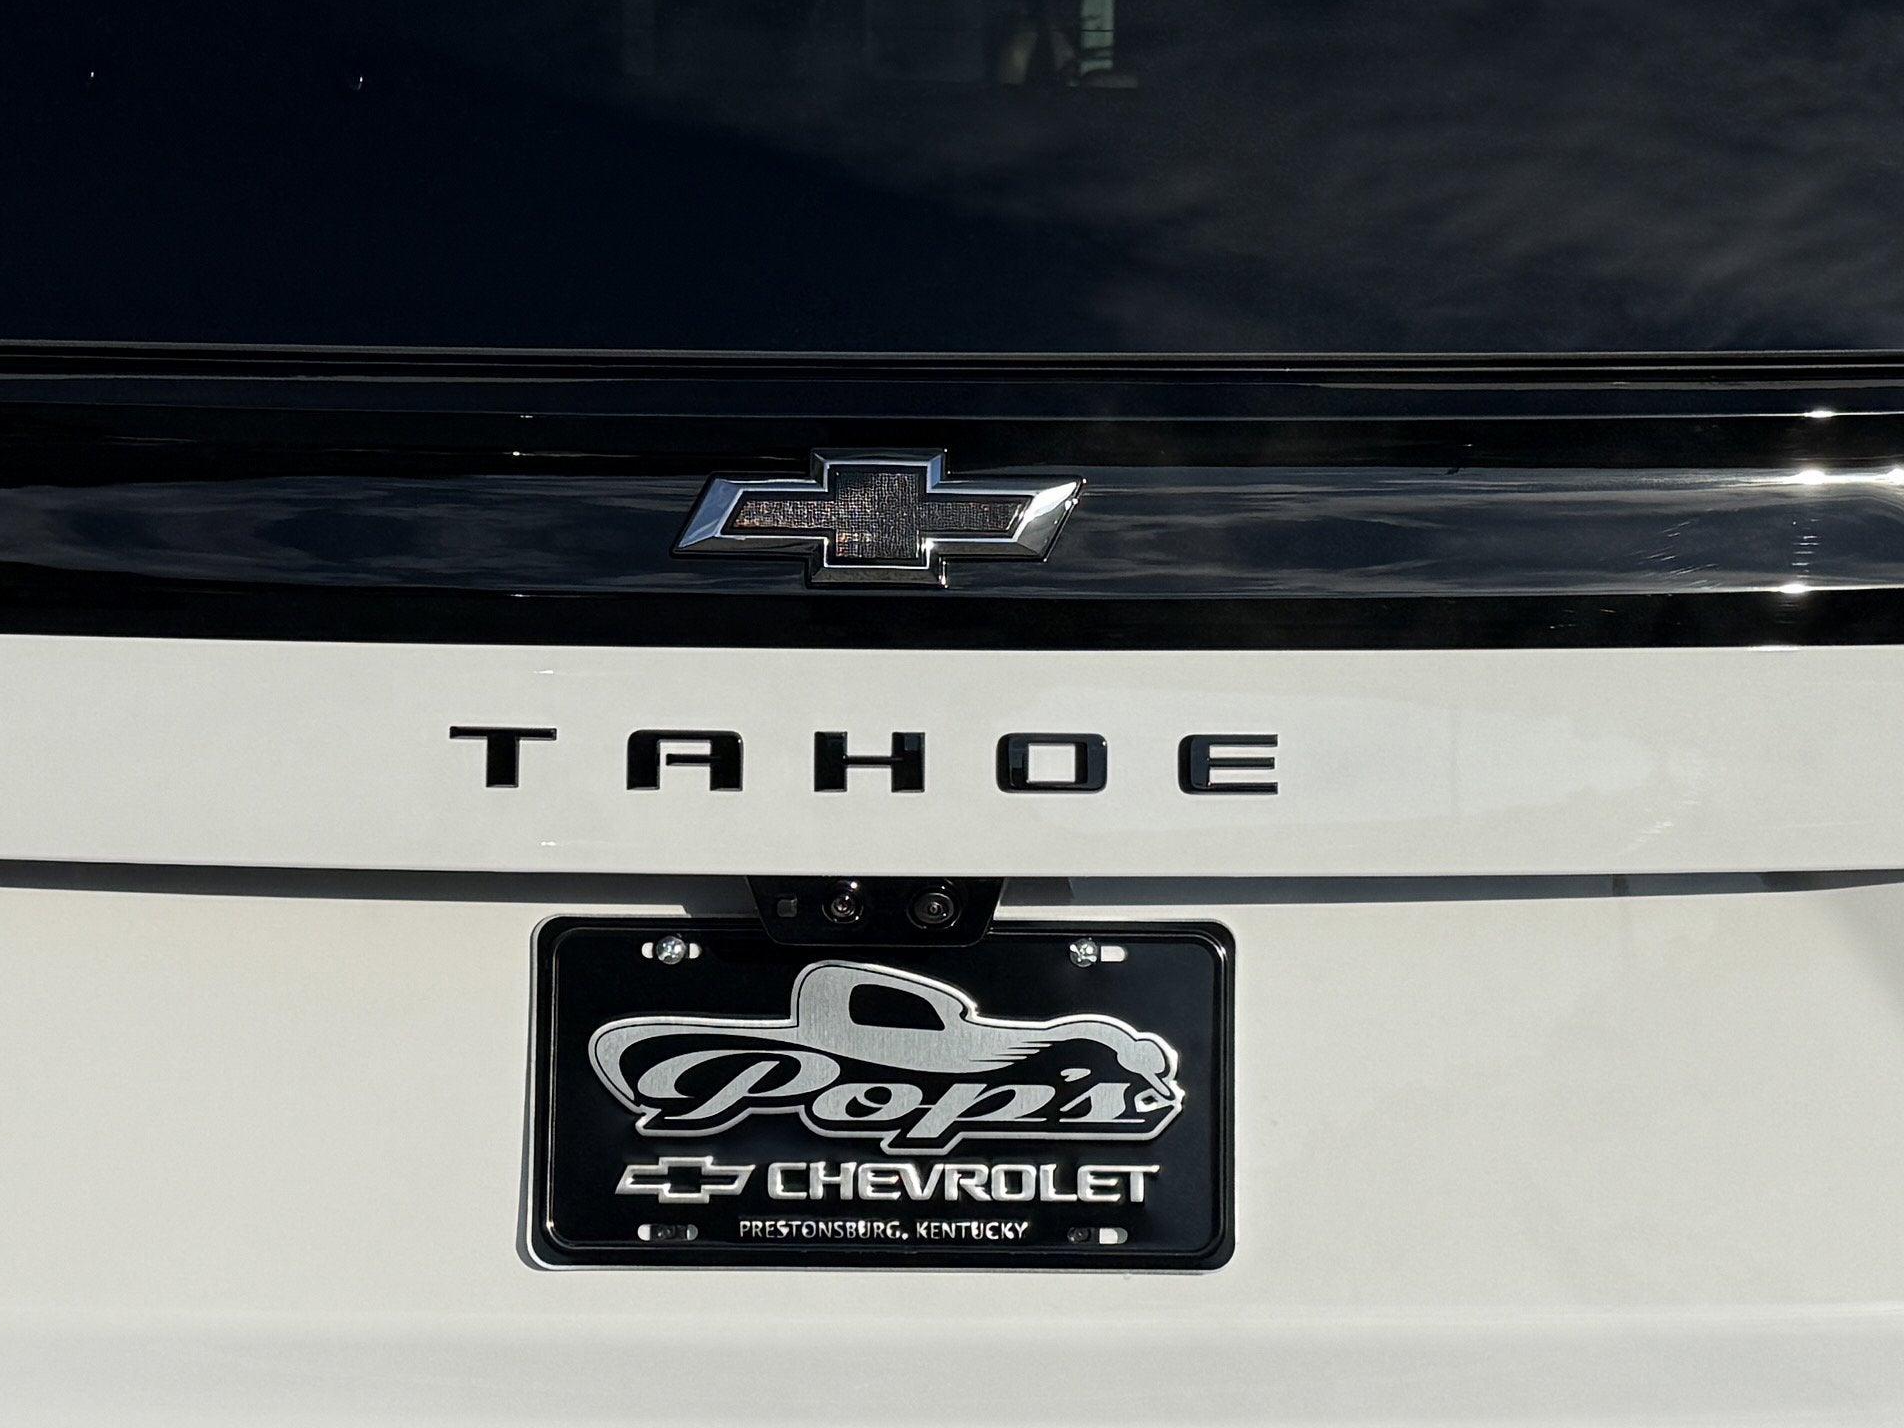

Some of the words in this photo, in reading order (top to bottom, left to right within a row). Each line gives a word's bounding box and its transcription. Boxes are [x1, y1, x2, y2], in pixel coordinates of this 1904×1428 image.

[448, 725, 1279, 795] TAHOE
[635, 1049, 1148, 1139] Pop's
[767, 1162, 1160, 1203] CHEVROLET
[915, 1220, 1029, 1240] KENTUCKY
